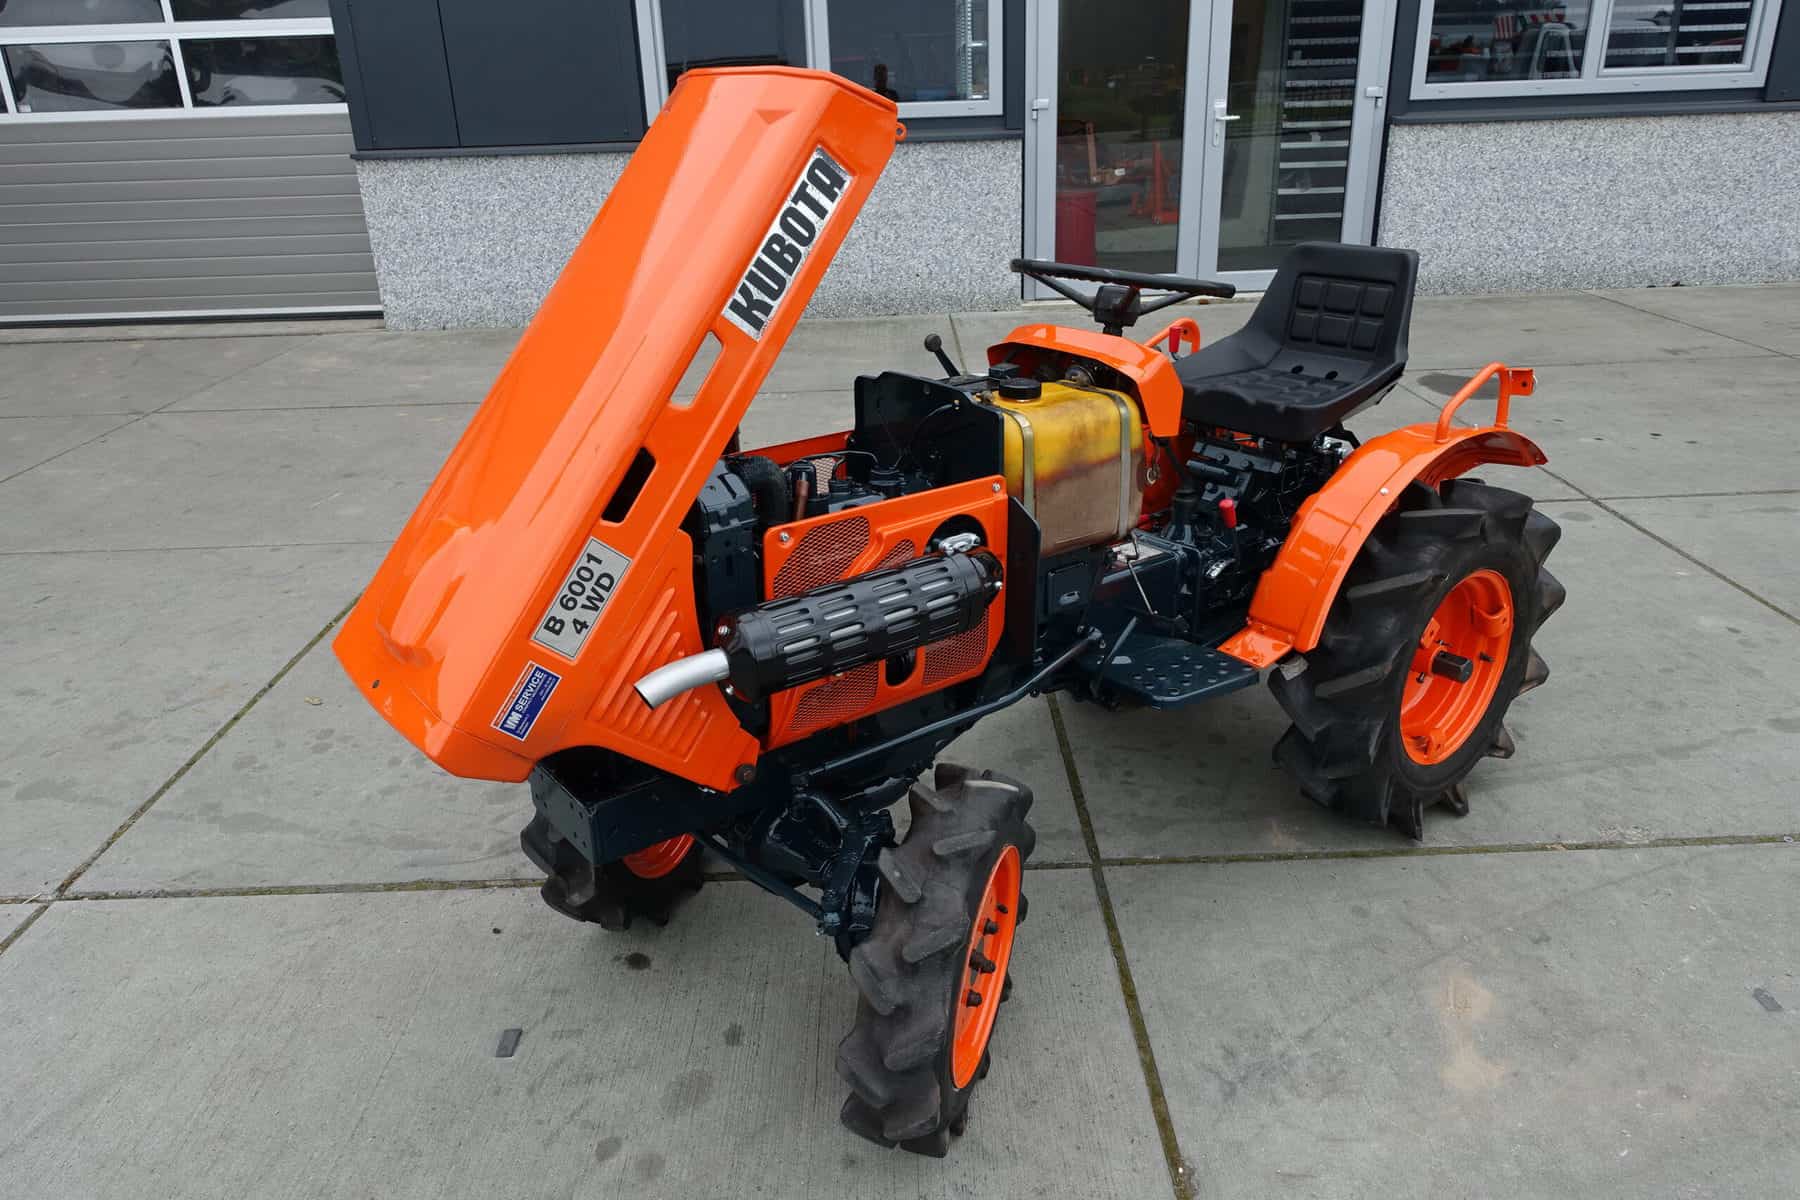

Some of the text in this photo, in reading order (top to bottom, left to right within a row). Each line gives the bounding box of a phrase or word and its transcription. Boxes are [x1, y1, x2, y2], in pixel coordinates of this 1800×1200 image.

[728, 157, 848, 333] KUBOTA
[543, 615, 566, 637] B
[559, 552, 603, 611] 6001
[572, 571, 615, 635] 4 WD
[504, 711, 522, 730] VM
[515, 670, 545, 712] SERVICE
